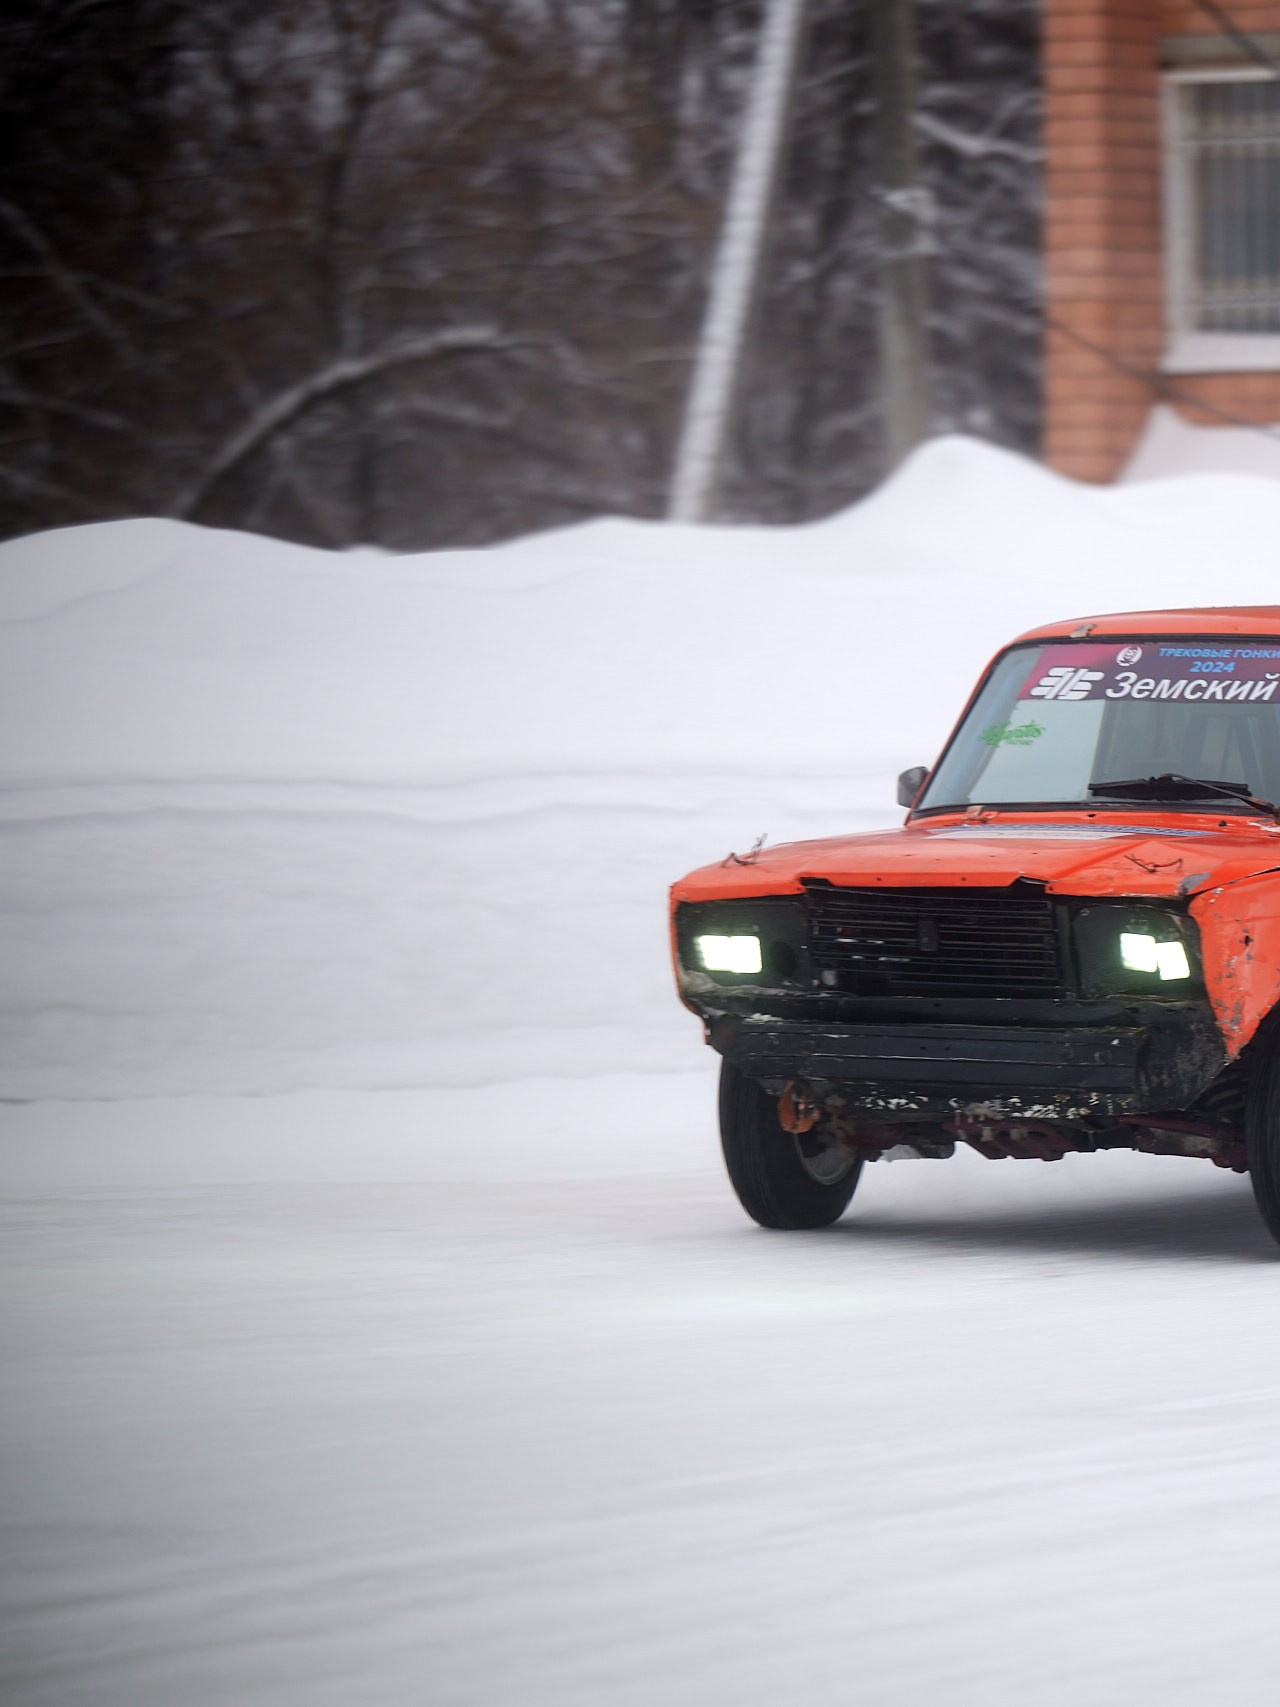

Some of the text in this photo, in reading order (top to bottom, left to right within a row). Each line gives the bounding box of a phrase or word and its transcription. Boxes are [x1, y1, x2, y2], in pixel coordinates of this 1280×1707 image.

[1159, 648, 1231, 658] ТРЕКОВЫЕ
[1189, 661, 1236, 673] 2024
[1105, 671, 1280, 701] Земский
